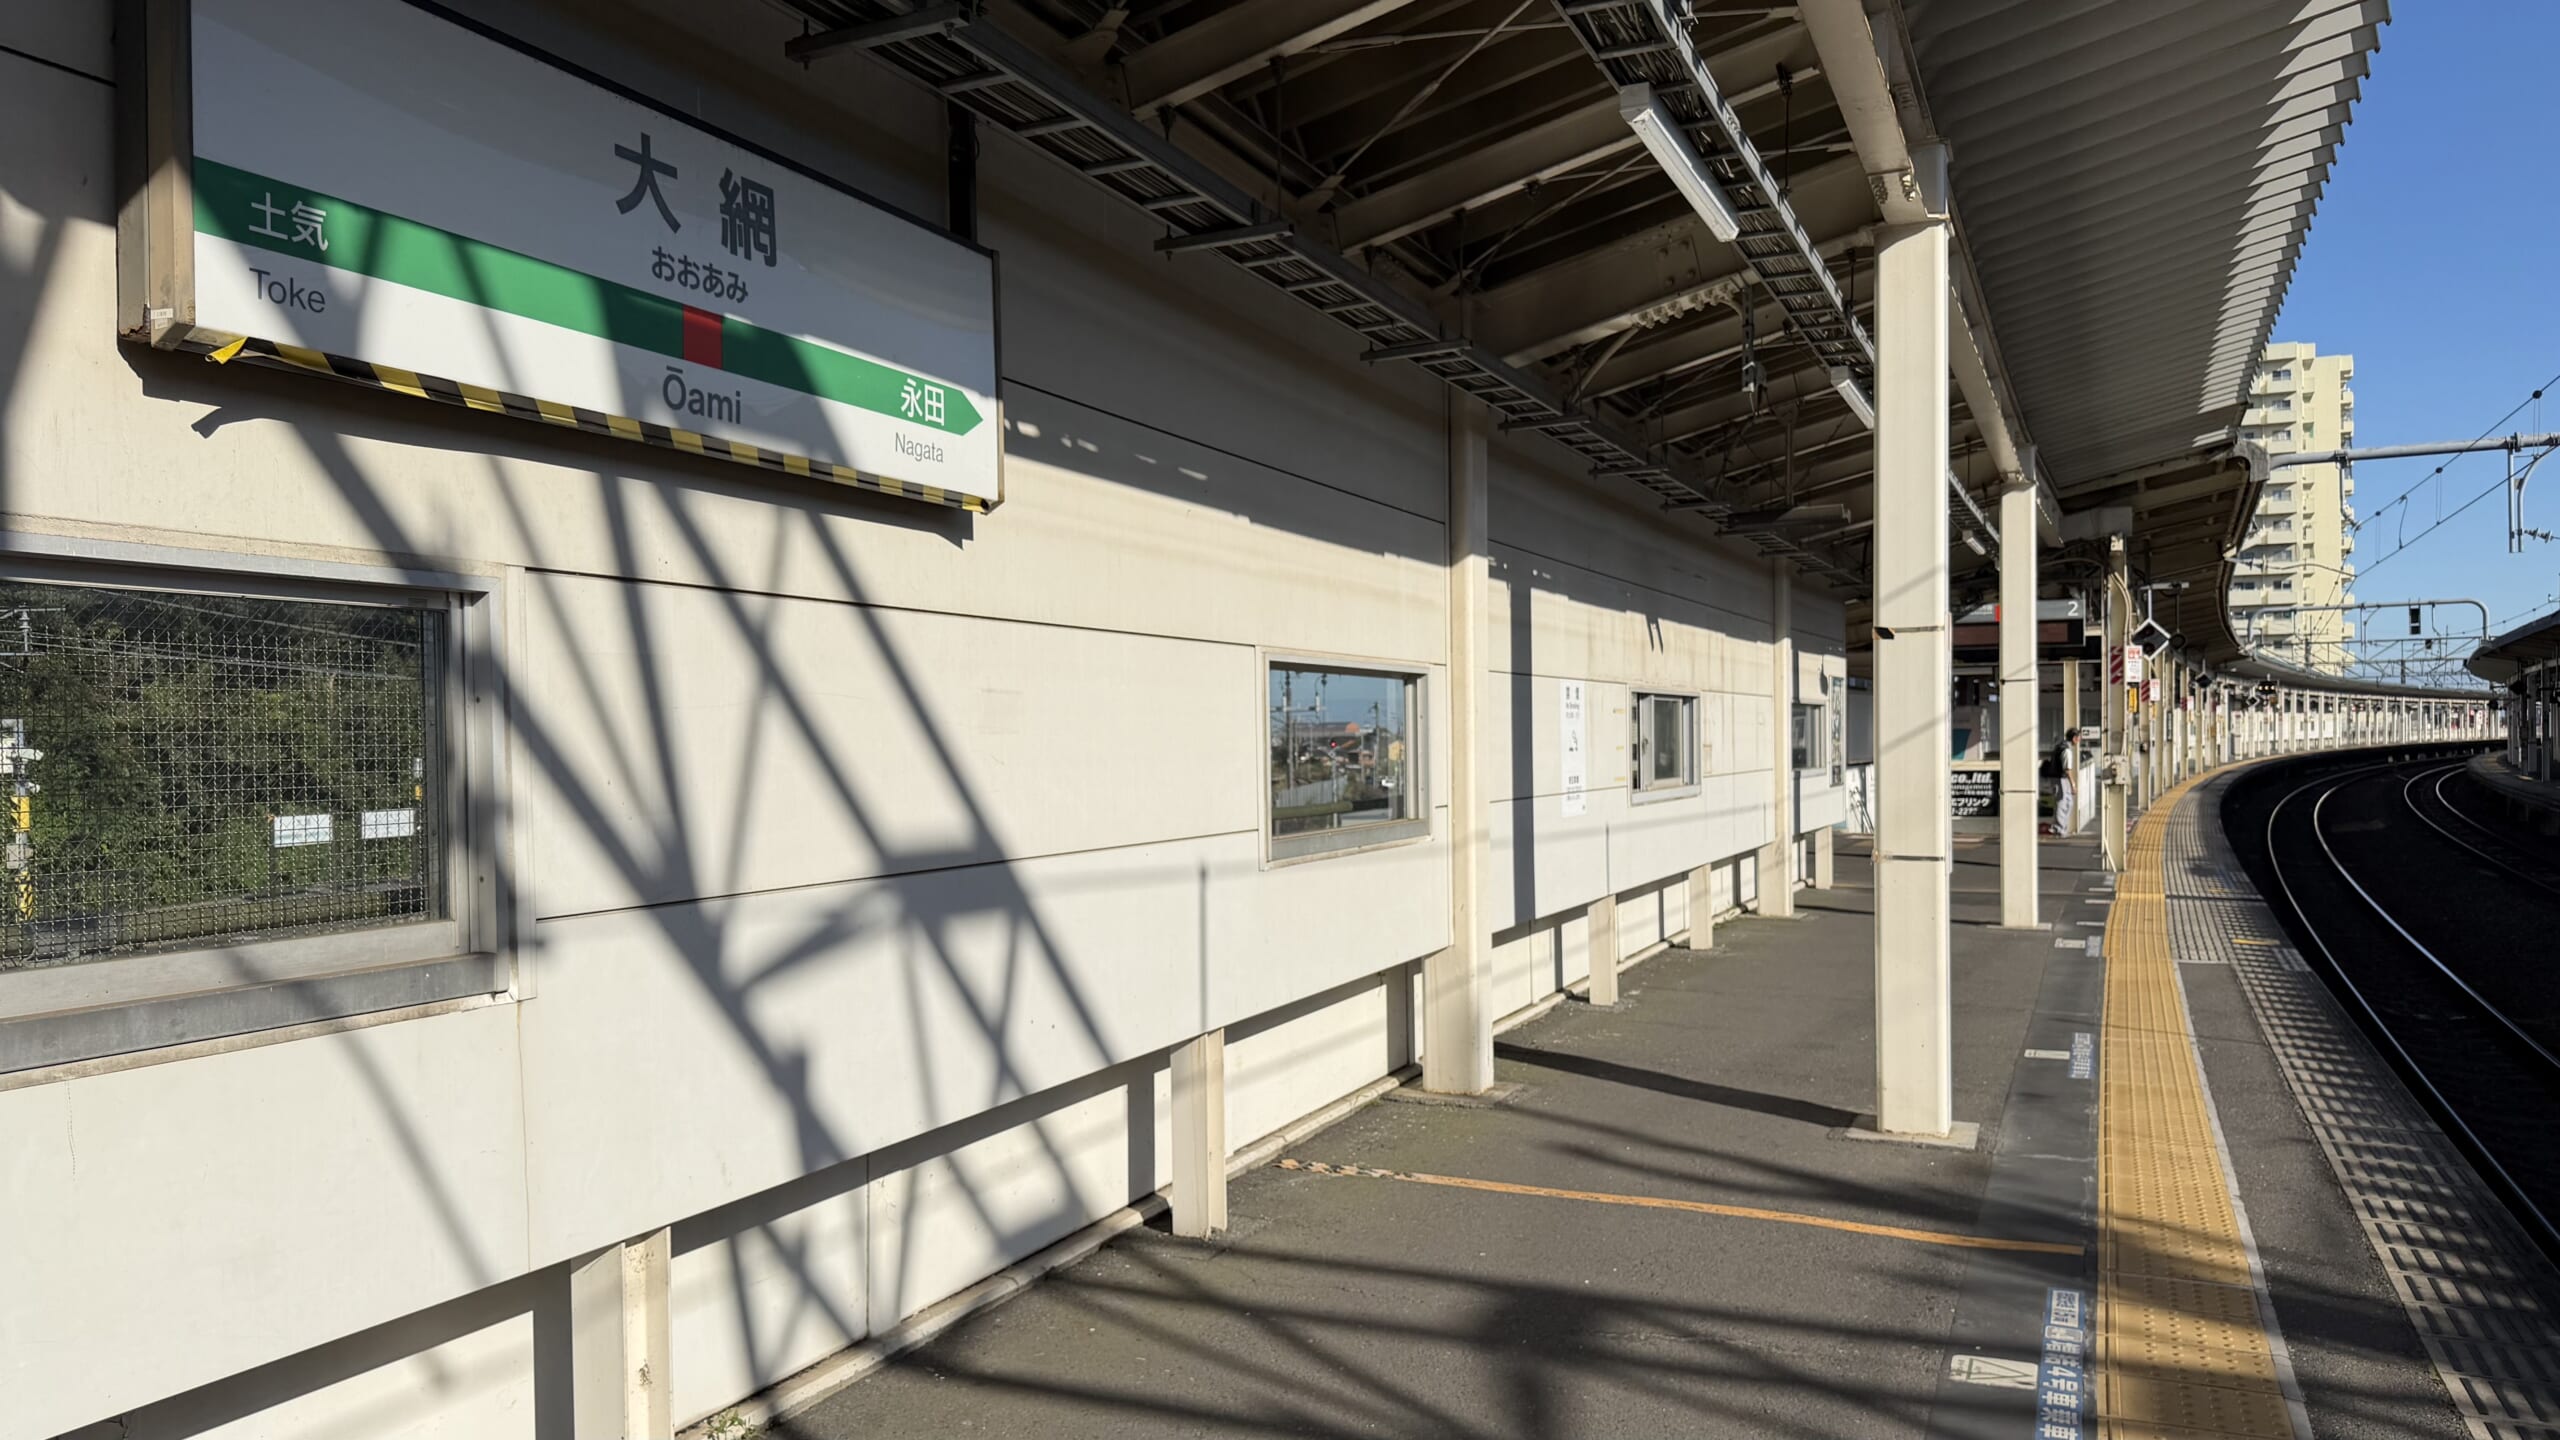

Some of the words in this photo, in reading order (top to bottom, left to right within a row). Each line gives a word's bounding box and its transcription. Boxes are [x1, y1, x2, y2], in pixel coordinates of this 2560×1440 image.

[248, 191, 329, 251] 土気
[614, 131, 777, 268] 大網
[249, 267, 326, 313] Toke
[651, 246, 748, 303] おおあみ
[663, 365, 741, 425] Ōami
[901, 377, 944, 427] 永田
[895, 431, 944, 464] Nagata
[2067, 600, 2079, 617] 2
